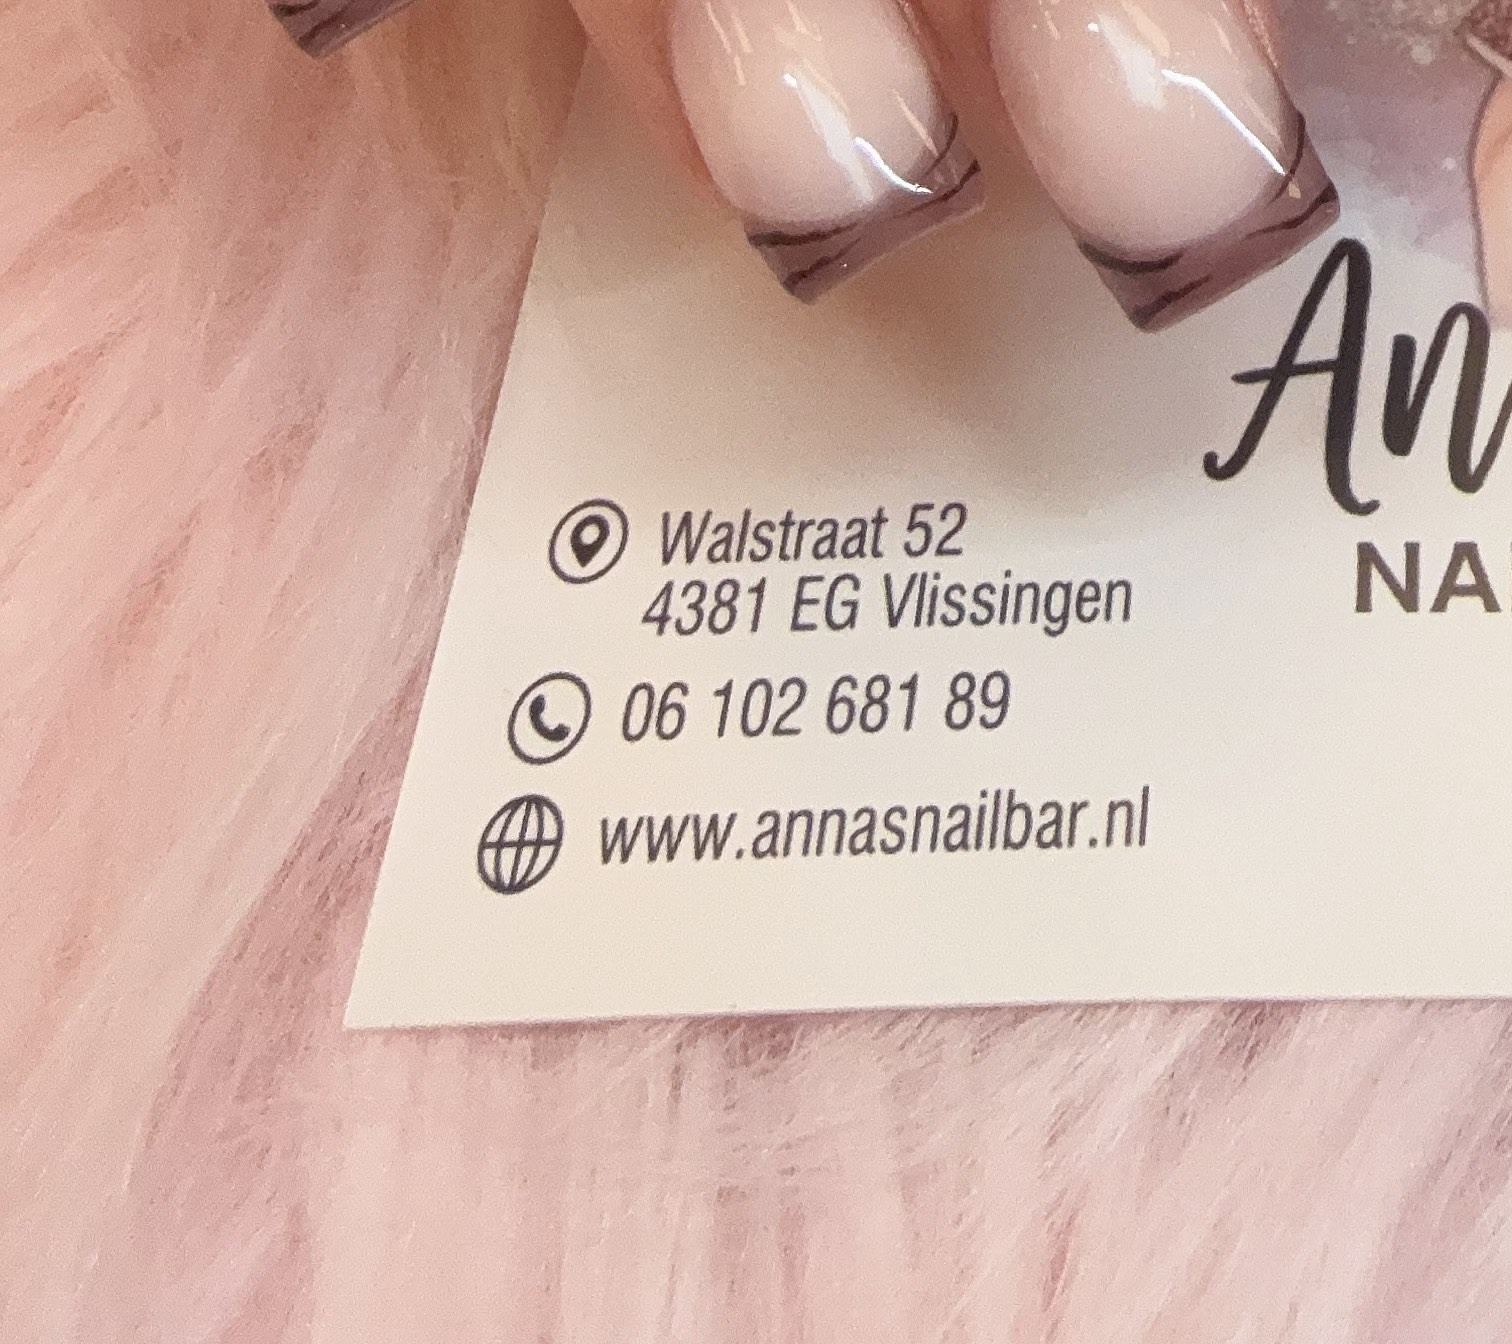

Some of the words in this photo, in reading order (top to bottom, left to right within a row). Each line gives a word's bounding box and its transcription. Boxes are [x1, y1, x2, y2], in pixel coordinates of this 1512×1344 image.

[660, 508, 889, 567] Walstraat
[902, 502, 969, 559] 52
[642, 576, 768, 637] 4381
[789, 572, 862, 633] EG
[883, 569, 1133, 638] Vlissingen
[621, 681, 690, 744] 06
[712, 675, 809, 740] 102
[825, 672, 920, 736] 681
[943, 669, 1012, 732] 89
[599, 785, 1151, 866] www.annasnailbar.nl
